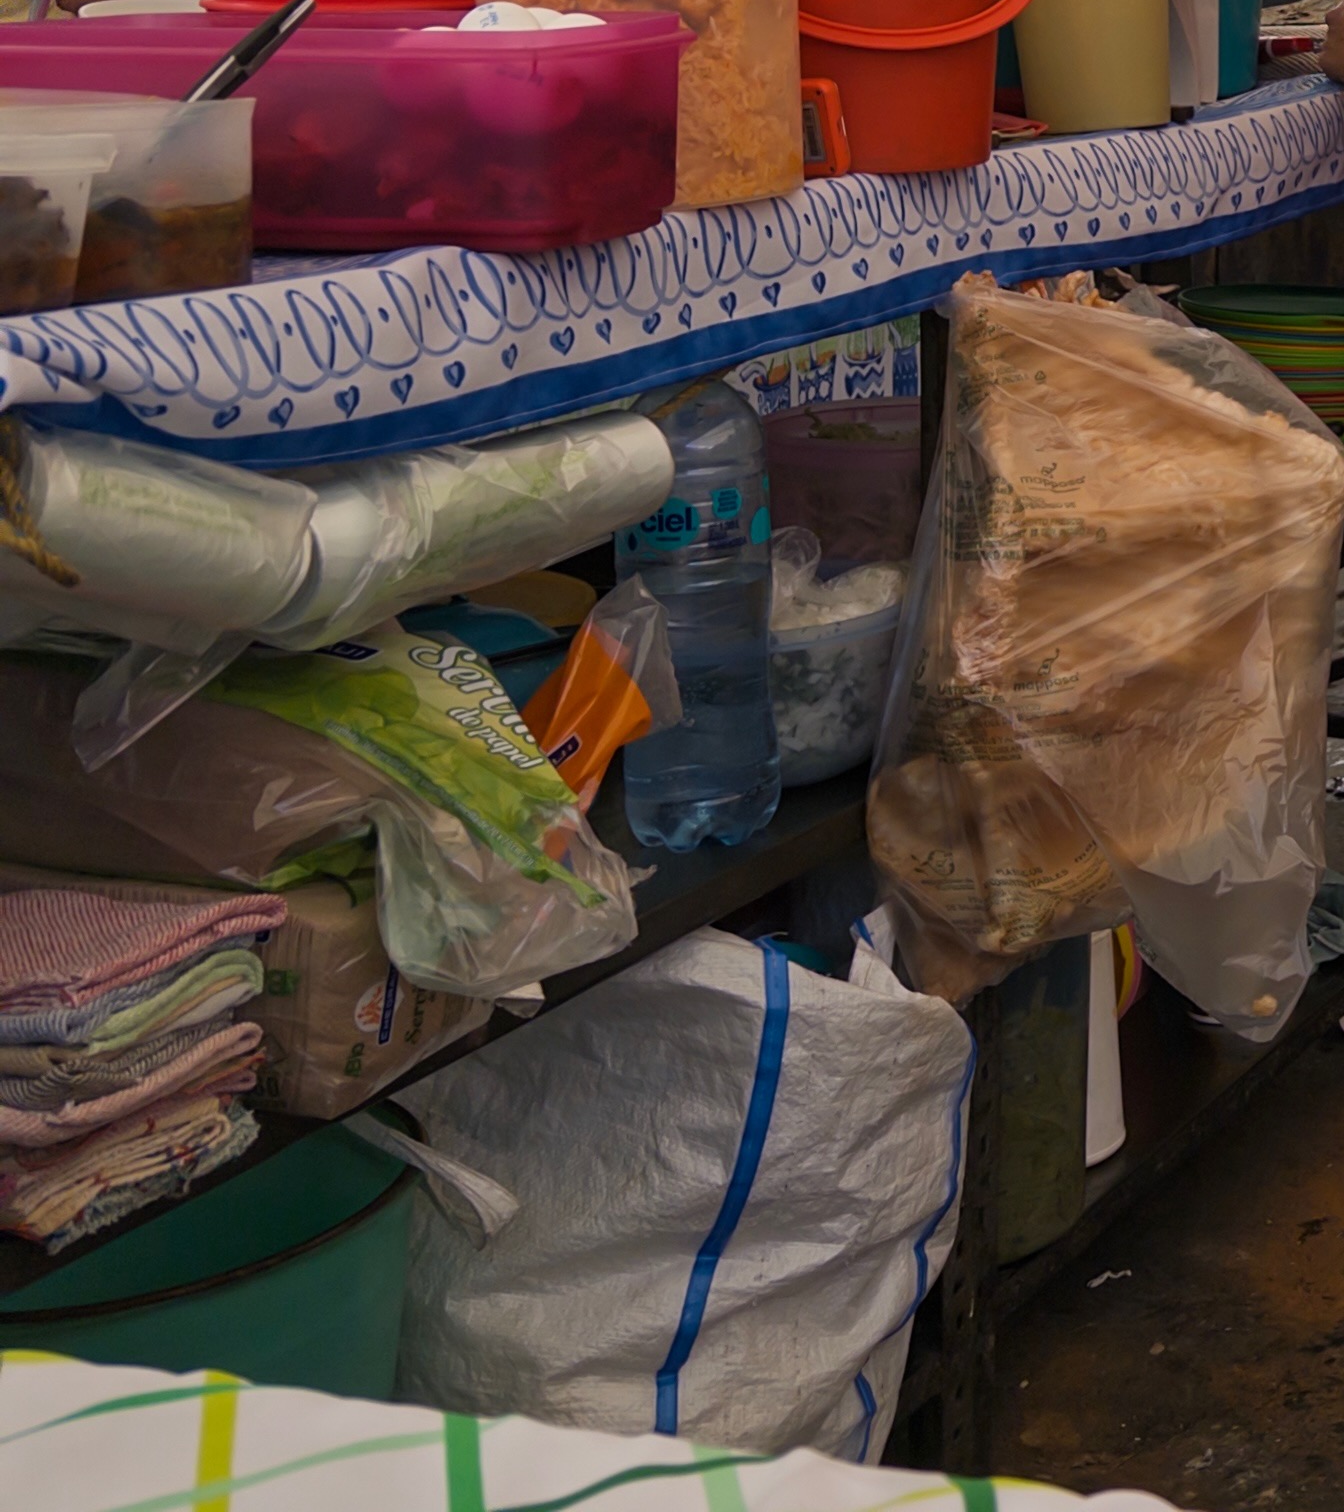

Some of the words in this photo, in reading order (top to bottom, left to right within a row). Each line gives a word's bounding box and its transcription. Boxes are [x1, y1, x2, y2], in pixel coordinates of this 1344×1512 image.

[640, 506, 692, 534] ciel
[446, 706, 483, 730] de
[465, 723, 545, 771] papel
